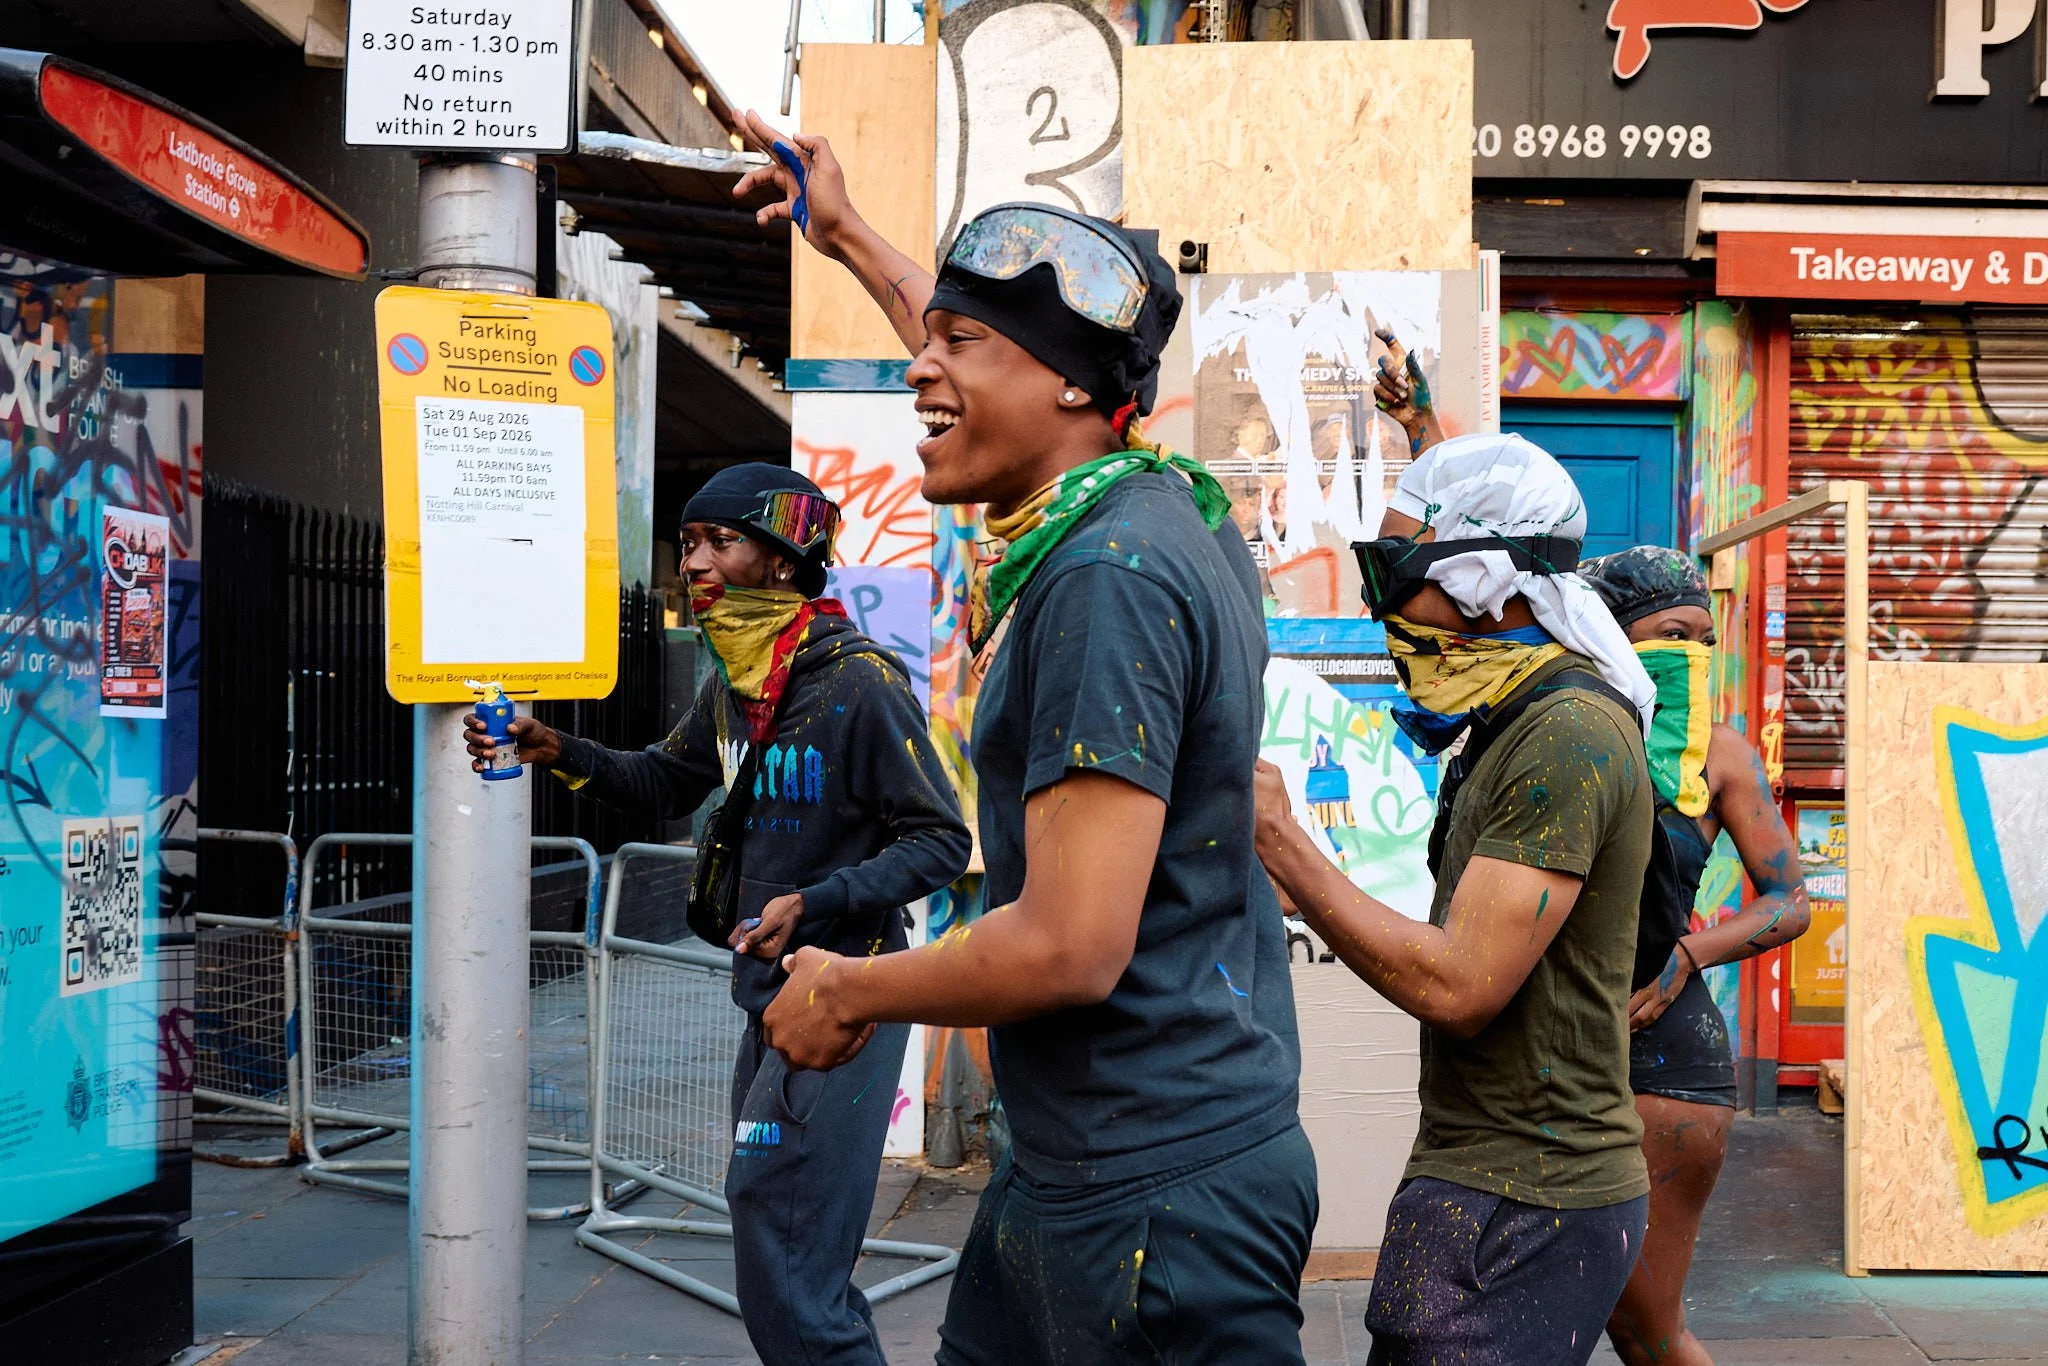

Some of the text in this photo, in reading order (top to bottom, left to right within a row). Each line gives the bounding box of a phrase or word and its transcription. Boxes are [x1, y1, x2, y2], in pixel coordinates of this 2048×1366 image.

[411, 7, 512, 29] Saturday
[362, 33, 414, 51] 8.30
[421, 38, 452, 51] am
[472, 36, 519, 53] 1.30
[526, 40, 558, 57] pm
[414, 64, 503, 83] 40 mins
[403, 94, 512, 113] No return
[1025, 85, 1071, 145] 2
[376, 118, 537, 138] within 2 hours
[1472, 123, 1712, 159] 0 8968 9998
[169, 132, 257, 198] Ladbroke Grove
[184, 172, 227, 214] Station
[1790, 247, 1973, 291] Takeaway
[1984, 250, 2011, 285] &
[459, 321, 537, 346] Parking
[438, 341, 558, 366] Suspension
[444, 375, 558, 403] No Loading
[423, 407, 529, 426] Sat 29 Aug 2026
[424, 424, 532, 442] Tue 01 Sep 2026
[424, 442, 448, 451] From
[450, 443, 474, 454] 11.59
[456, 459, 552, 473] ALL PARKING BAYS
[462, 472, 548, 486] 11.59pm TO 6am
[453, 487, 471, 497] ALL
[474, 487, 501, 498] DAYS
[504, 489, 556, 501] INCLUSIVE
[426, 499, 465, 512] Notting
[485, 501, 525, 512] Carnival
[396, 674, 413, 683] The
[417, 673, 443, 684] Royal
[490, 672, 499, 681] of
[502, 671, 552, 683] Kensington
[554, 671, 572, 681] and
[574, 671, 608, 681] Chelsea
